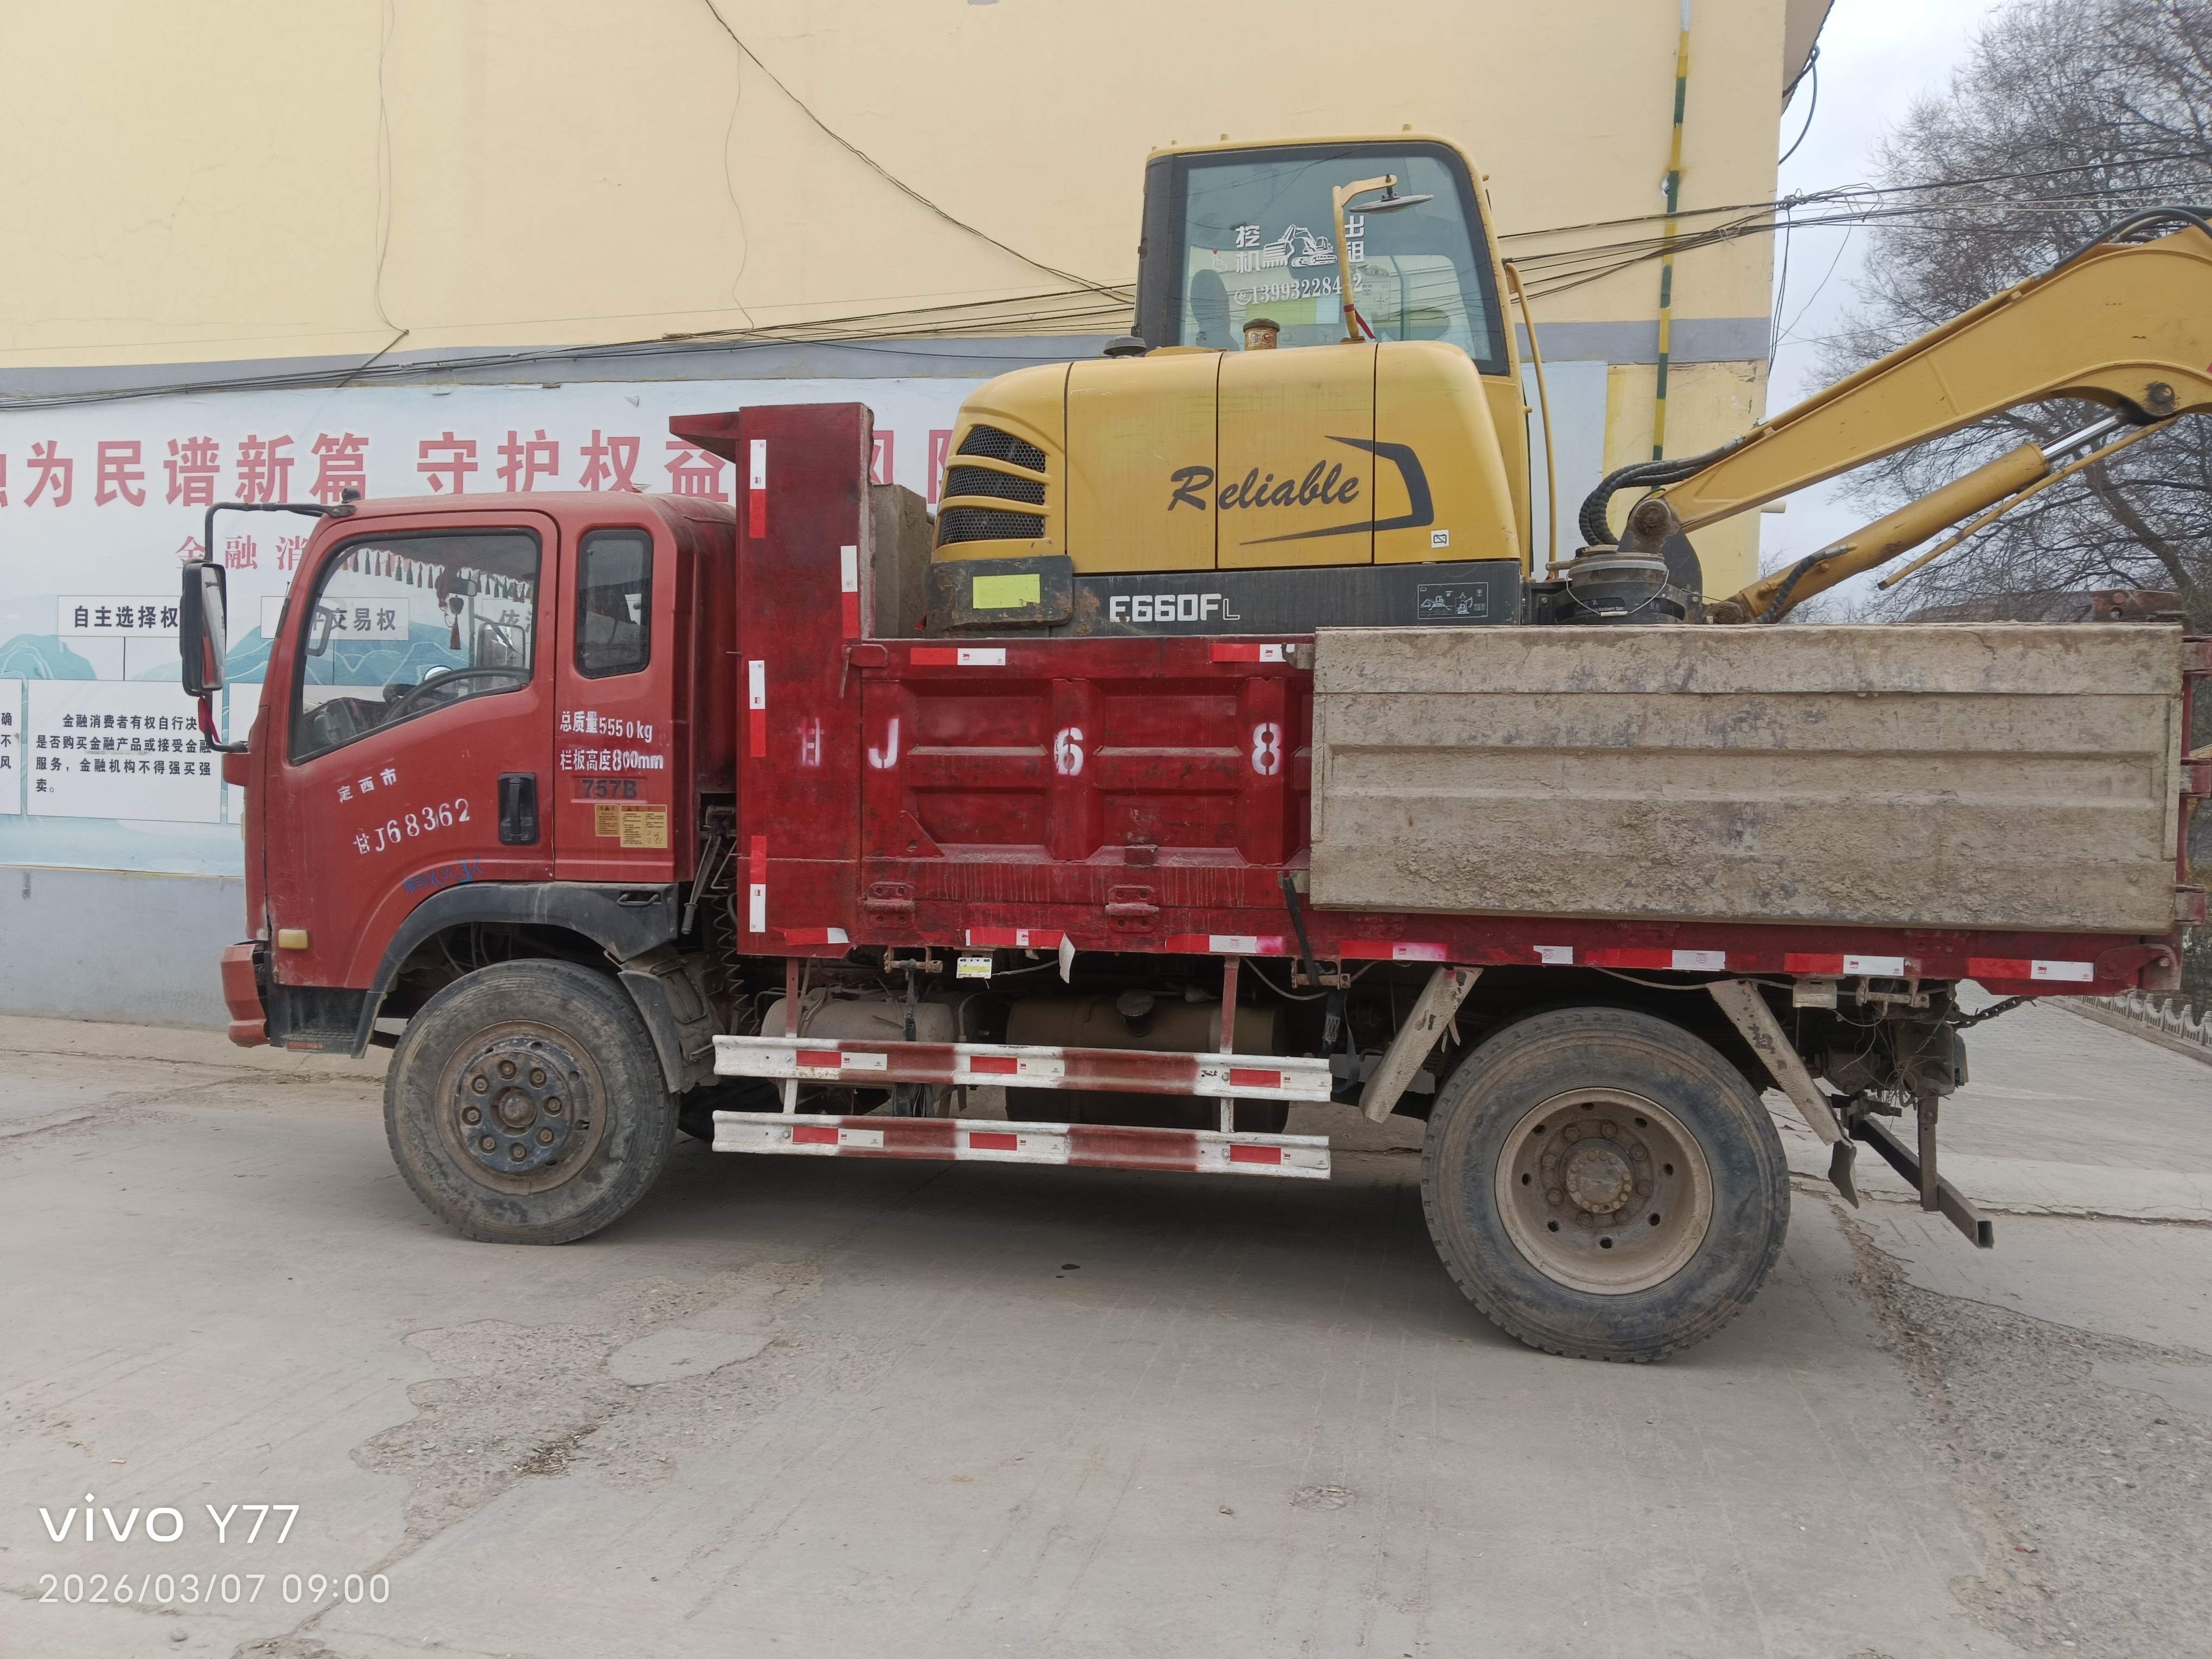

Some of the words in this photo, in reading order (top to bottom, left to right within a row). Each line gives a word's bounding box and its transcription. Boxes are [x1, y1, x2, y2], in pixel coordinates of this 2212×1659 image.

[1236, 225, 1261, 273] 挖机
[1251, 273, 1362, 304] 1399322842
[0, 433, 369, 507] 为民谱新篇
[1168, 460, 1359, 511] Reliable
[75, 606, 178, 628] 自主选择权
[63, 714, 197, 730] 金融消费者有权自行决
[1, 735, 11, 748] 不
[869, 718, 899, 769] J
[1054, 727, 1083, 776] 6
[1251, 723, 1282, 776] 8
[36, 757, 211, 776] 服务,金融机构不得强买强
[337, 768, 396, 803] 定西市
[353, 798, 470, 854] 甘J68362
